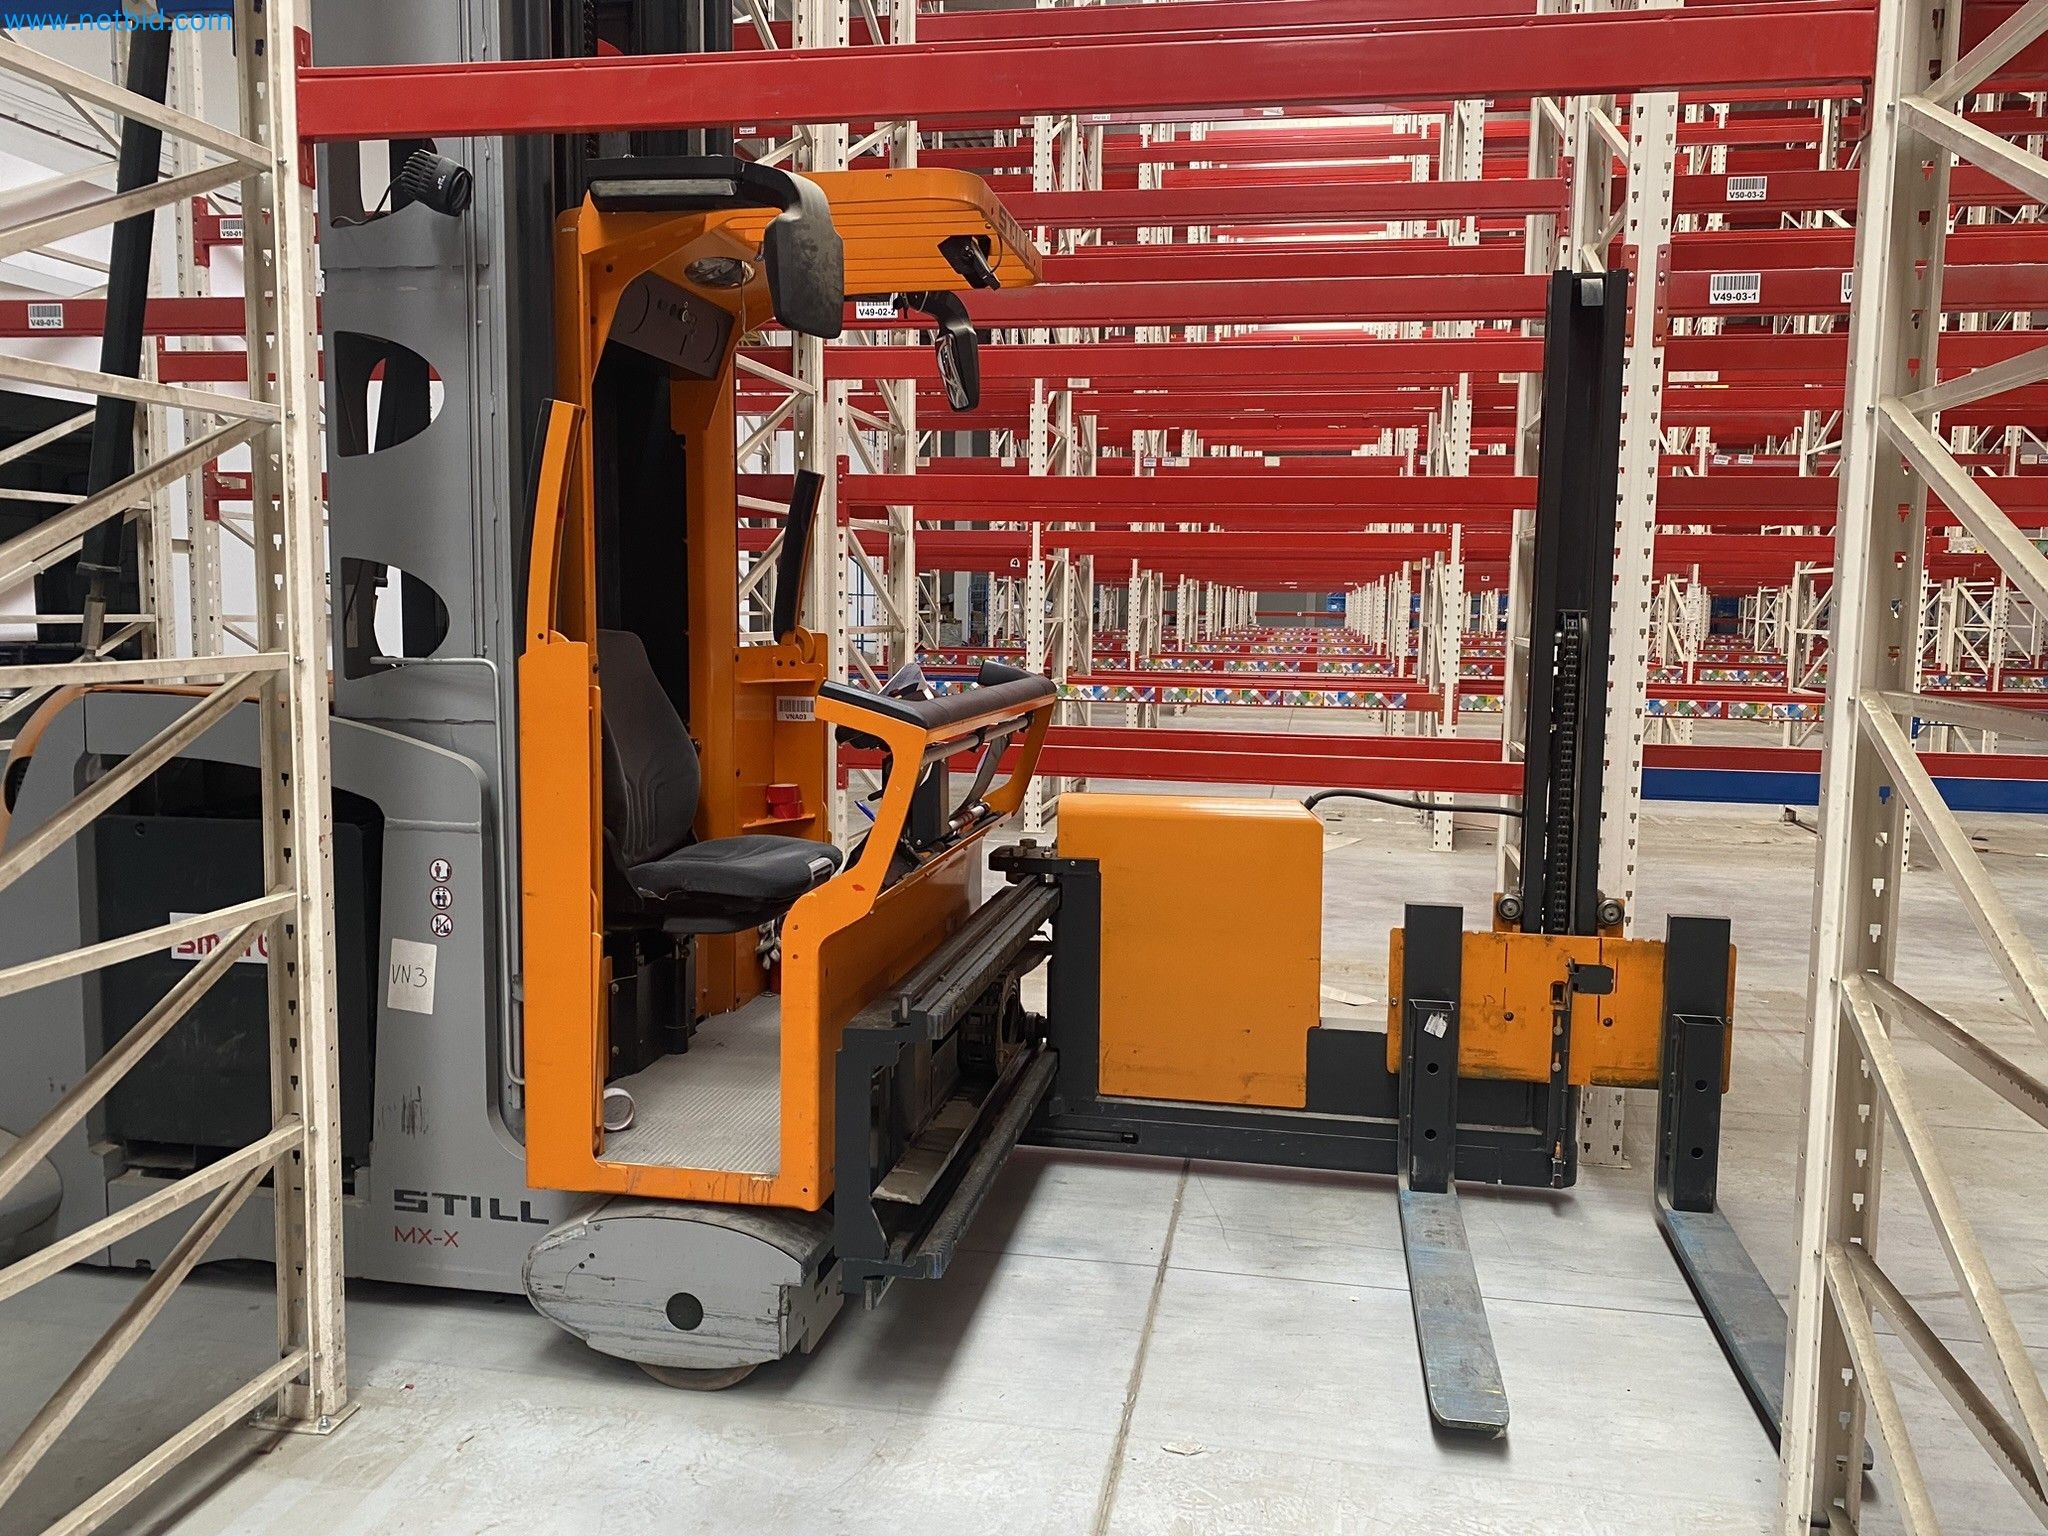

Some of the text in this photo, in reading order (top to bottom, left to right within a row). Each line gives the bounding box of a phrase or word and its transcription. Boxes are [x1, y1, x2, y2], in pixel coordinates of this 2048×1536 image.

[1713, 292, 1757, 301] V49-03-1
[859, 308, 896, 316] V49-02-2
[394, 1189, 550, 1226] STILL
[394, 1225, 459, 1249] MX-X
